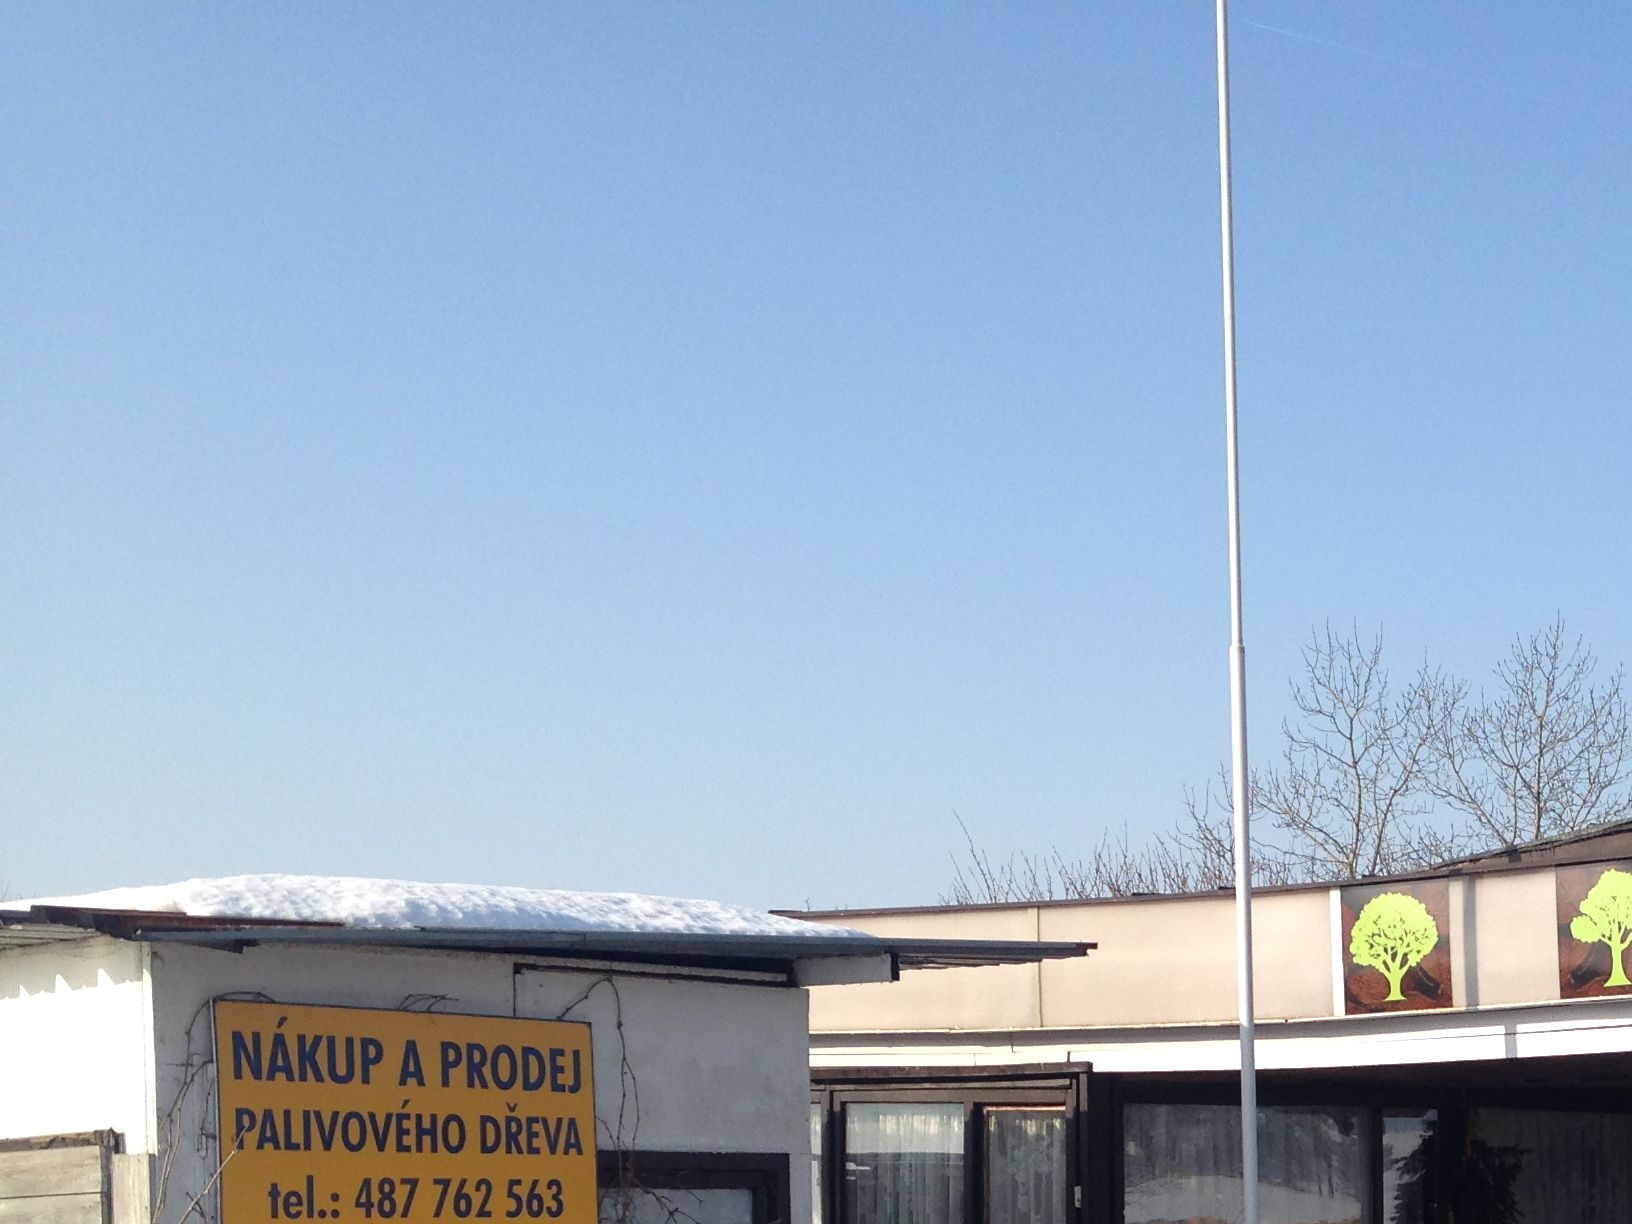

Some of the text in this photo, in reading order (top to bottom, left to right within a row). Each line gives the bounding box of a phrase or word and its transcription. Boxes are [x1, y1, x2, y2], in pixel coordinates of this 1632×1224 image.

[232, 1017, 582, 1094] NÁKUP A PRODEJ
[235, 1100, 584, 1156] PALIVOVÉHO DŘEVA
[268, 1176, 564, 1219] tel.: 487 762 563
